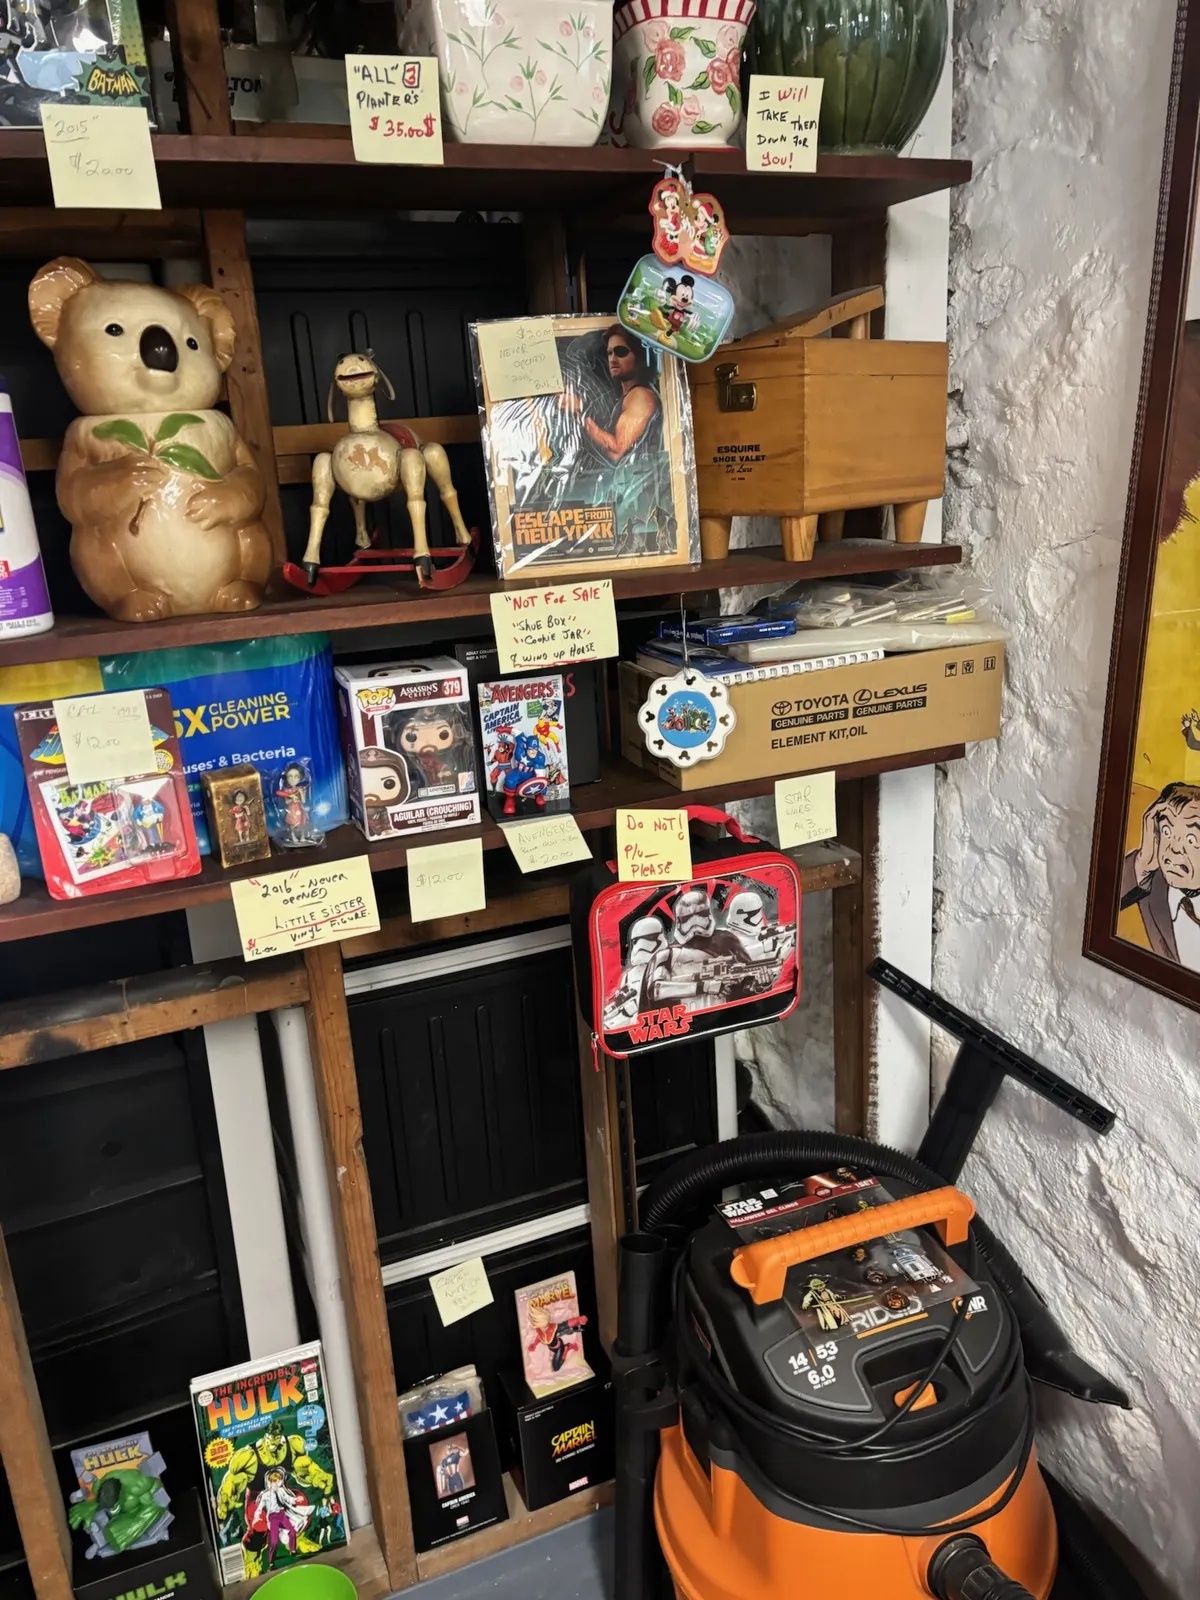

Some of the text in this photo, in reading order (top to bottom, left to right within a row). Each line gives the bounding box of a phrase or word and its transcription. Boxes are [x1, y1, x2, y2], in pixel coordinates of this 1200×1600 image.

[88, 68, 140, 95] BATMAN
[759, 91, 770, 100] I
[757, 109, 789, 122] TAKE
[717, 444, 760, 453] ESQUIRE
[739, 454, 766, 463] VALET
[513, 508, 585, 529] ESCAPE
[585, 509, 613, 520] FROM
[515, 522, 614, 545] NEW YORK
[358, 687, 394, 708] POP!
[442, 680, 461, 695] 379
[491, 681, 554, 704] AVENGERS
[794, 684, 928, 711] TOYOTA LEXUS
[208, 692, 288, 715] CLEANING
[483, 702, 520, 723] CAPTAIN
[775, 699, 924, 729] GENUINE PARTS GENUINE PARTS
[211, 704, 291, 732] POWER
[485, 710, 520, 731] AMERICA
[771, 731, 826, 749] ELEMENT
[218, 756, 228, 767] &
[231, 746, 296, 765] Bacteria
[784, 785, 811, 804] STAR
[394, 801, 472, 822] AGUILAR (CROUCHING)
[637, 1003, 688, 1027] STAR
[628, 1016, 693, 1044] WARS
[722, 1202, 763, 1217] WARS
[725, 1198, 759, 1208] STAR
[730, 1211, 766, 1224] HALLOWEEN
[529, 1287, 576, 1308] MARVEL
[850, 1296, 923, 1333] RIDGD
[788, 1340, 839, 1370] 14 53
[213, 1385, 232, 1397] THE
[236, 1365, 297, 1390] INCREDIBLE
[808, 1364, 835, 1385] 6.0
[206, 1375, 304, 1431] HULK
[551, 1420, 595, 1447] CAPTAIN
[552, 1431, 597, 1458] MARVEL
[83, 1445, 143, 1471] HULK
[107, 1571, 188, 1600] ULK
